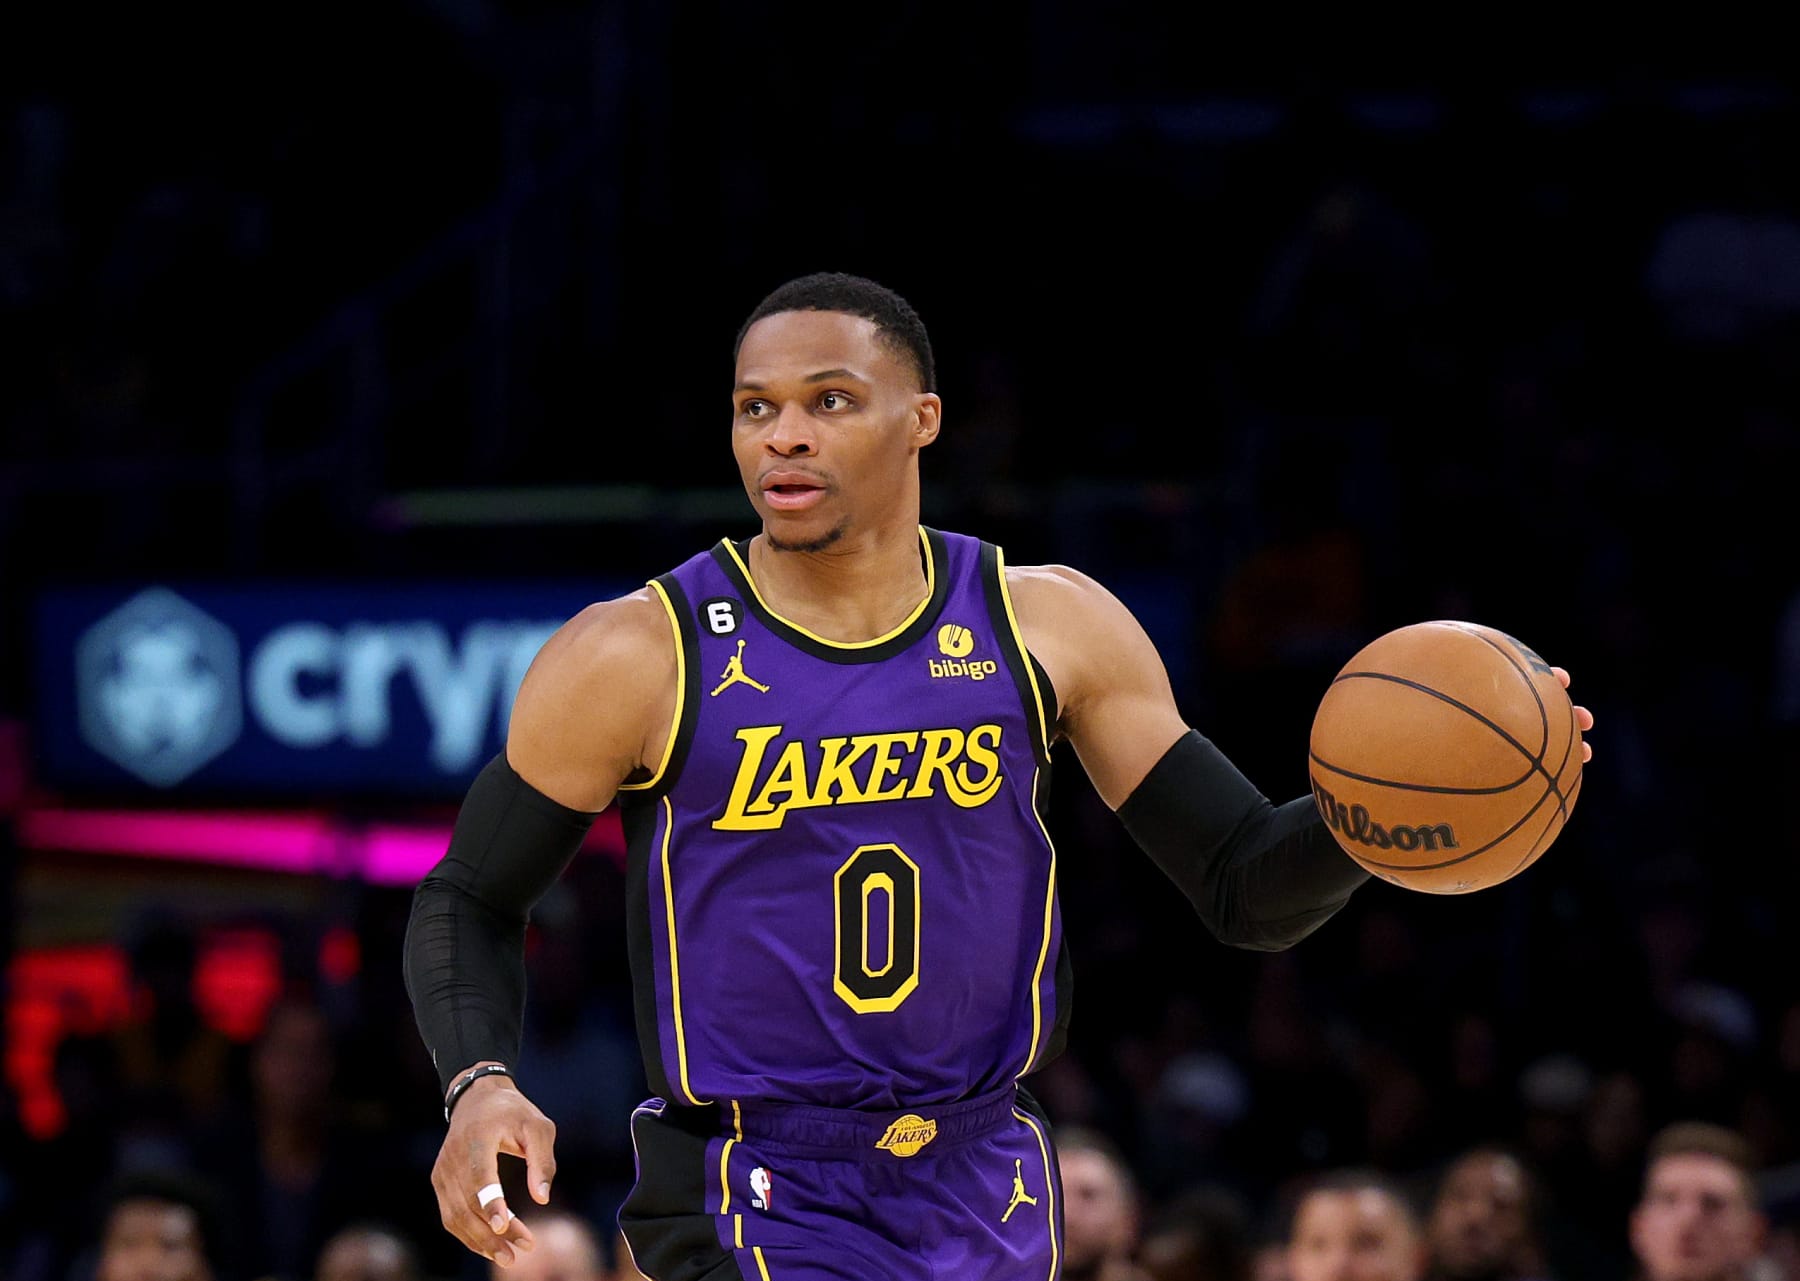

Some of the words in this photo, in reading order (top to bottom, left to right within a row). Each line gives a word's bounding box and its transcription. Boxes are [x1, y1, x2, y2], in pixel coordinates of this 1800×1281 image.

[708, 601, 735, 633] 6
[928, 659, 997, 681] bibigo
[712, 724, 1003, 831] LAKERS
[834, 843, 920, 1014] 0
